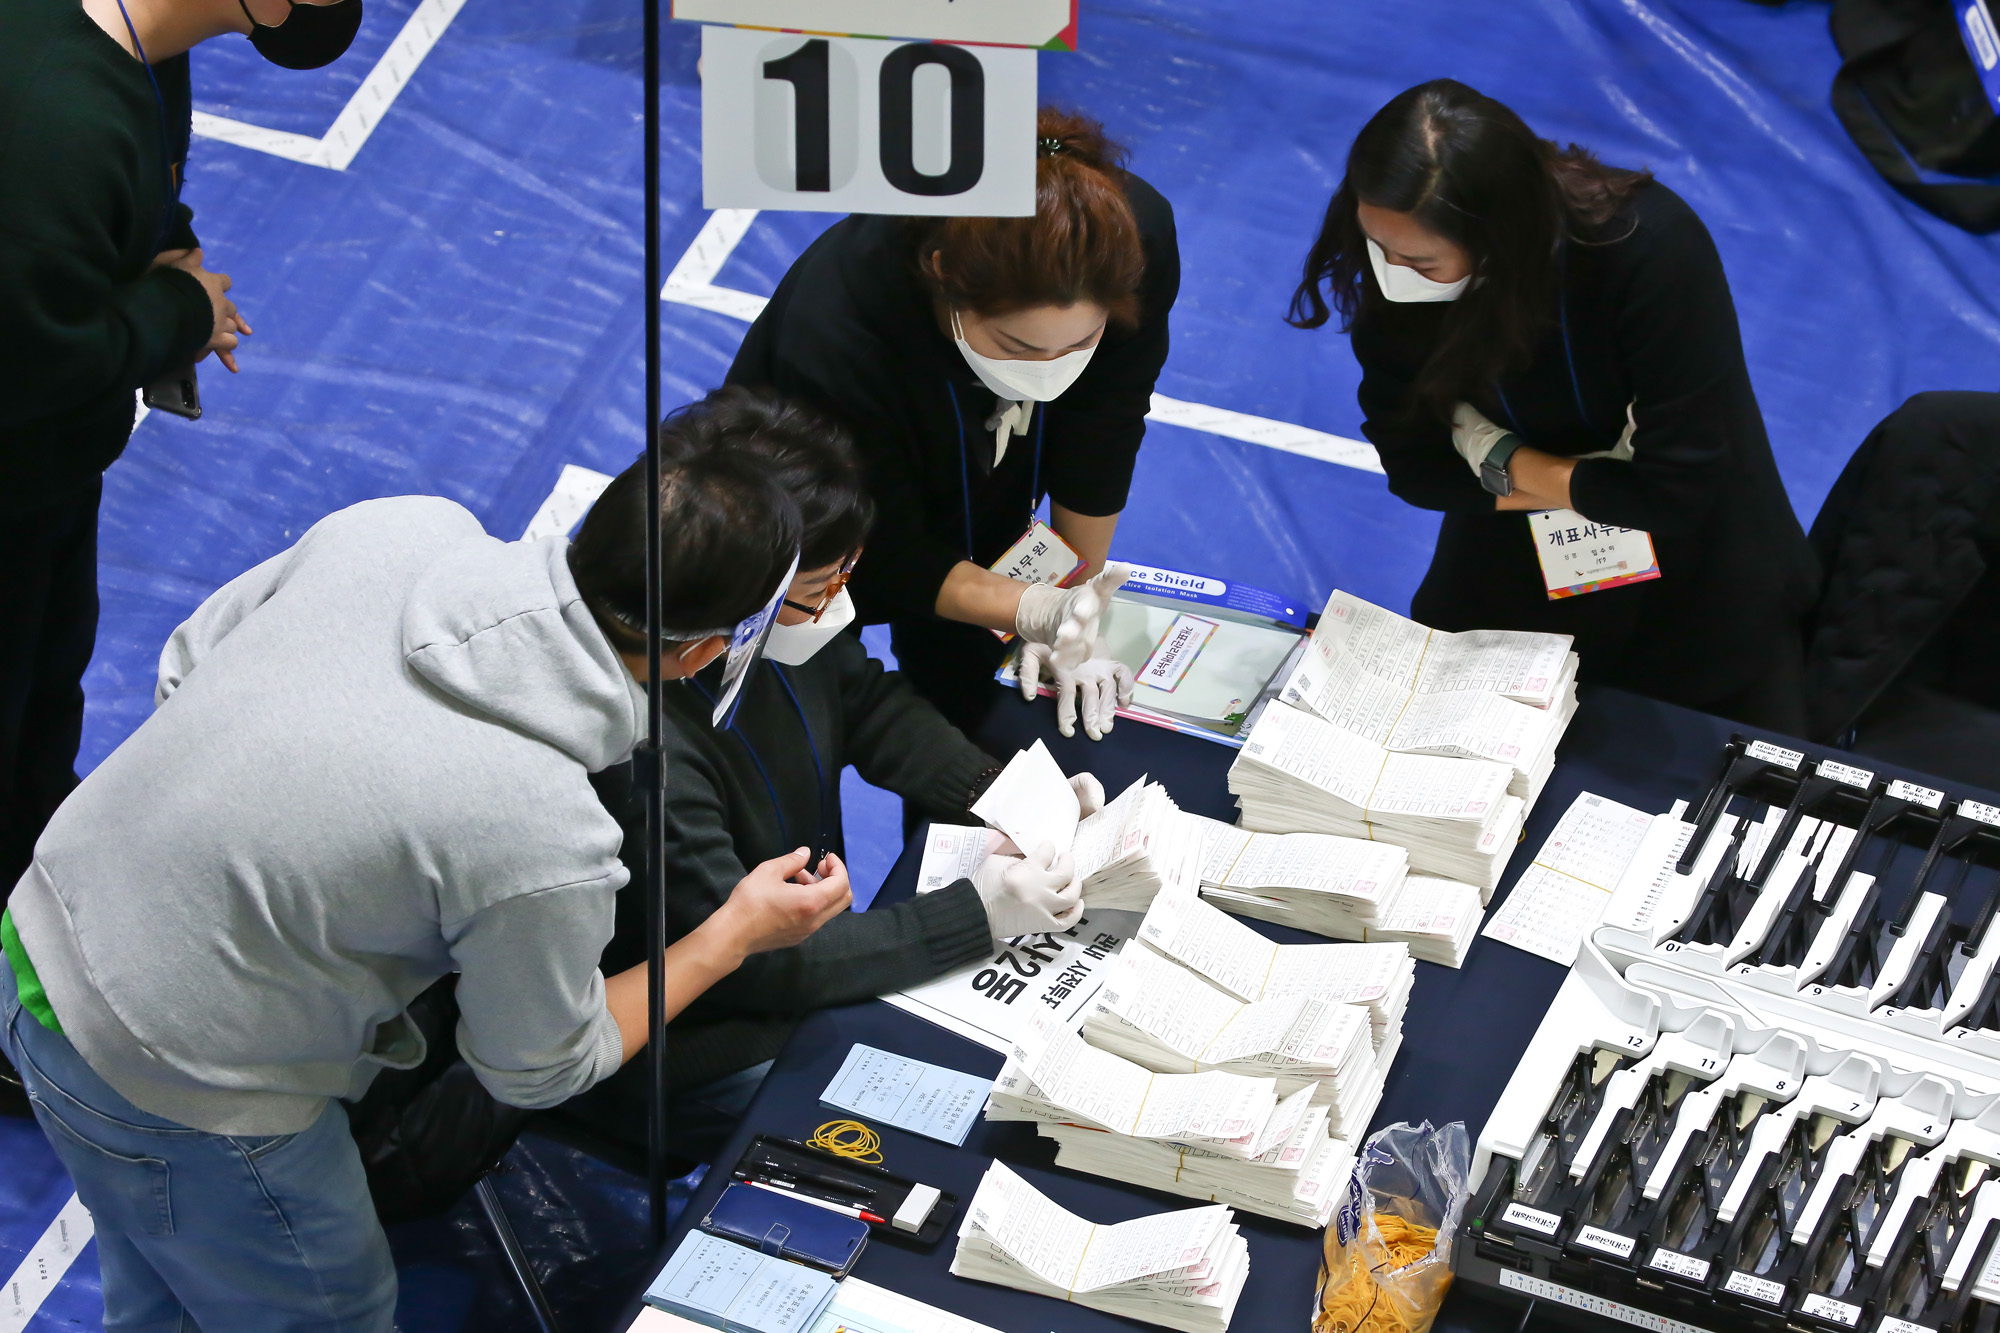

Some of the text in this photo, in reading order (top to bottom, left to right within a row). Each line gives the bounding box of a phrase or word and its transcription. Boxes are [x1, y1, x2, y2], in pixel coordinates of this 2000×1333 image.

[763, 39, 985, 196] 10
[1548, 522, 1633, 546] 개표사무
[1153, 572, 1205, 590] Shield
[1145, 585, 1176, 595] Isolation
[1180, 591, 1198, 599] Mask
[1150, 625, 1194, 677] 개표관리매뉴얼
[1083, 932, 1120, 960] 관내
[1664, 943, 1681, 953] 10
[1958, 1030, 1968, 1038] 2
[1626, 1036, 1643, 1048] 12
[1700, 1058, 1716, 1070] 11
[1776, 1080, 1786, 1090] 8
[1850, 1102, 1860, 1112] 7
[1923, 1125, 1932, 1134] 4
[1510, 1210, 1557, 1229] 재확인대상
[1585, 1232, 1631, 1252] 재확인대상
